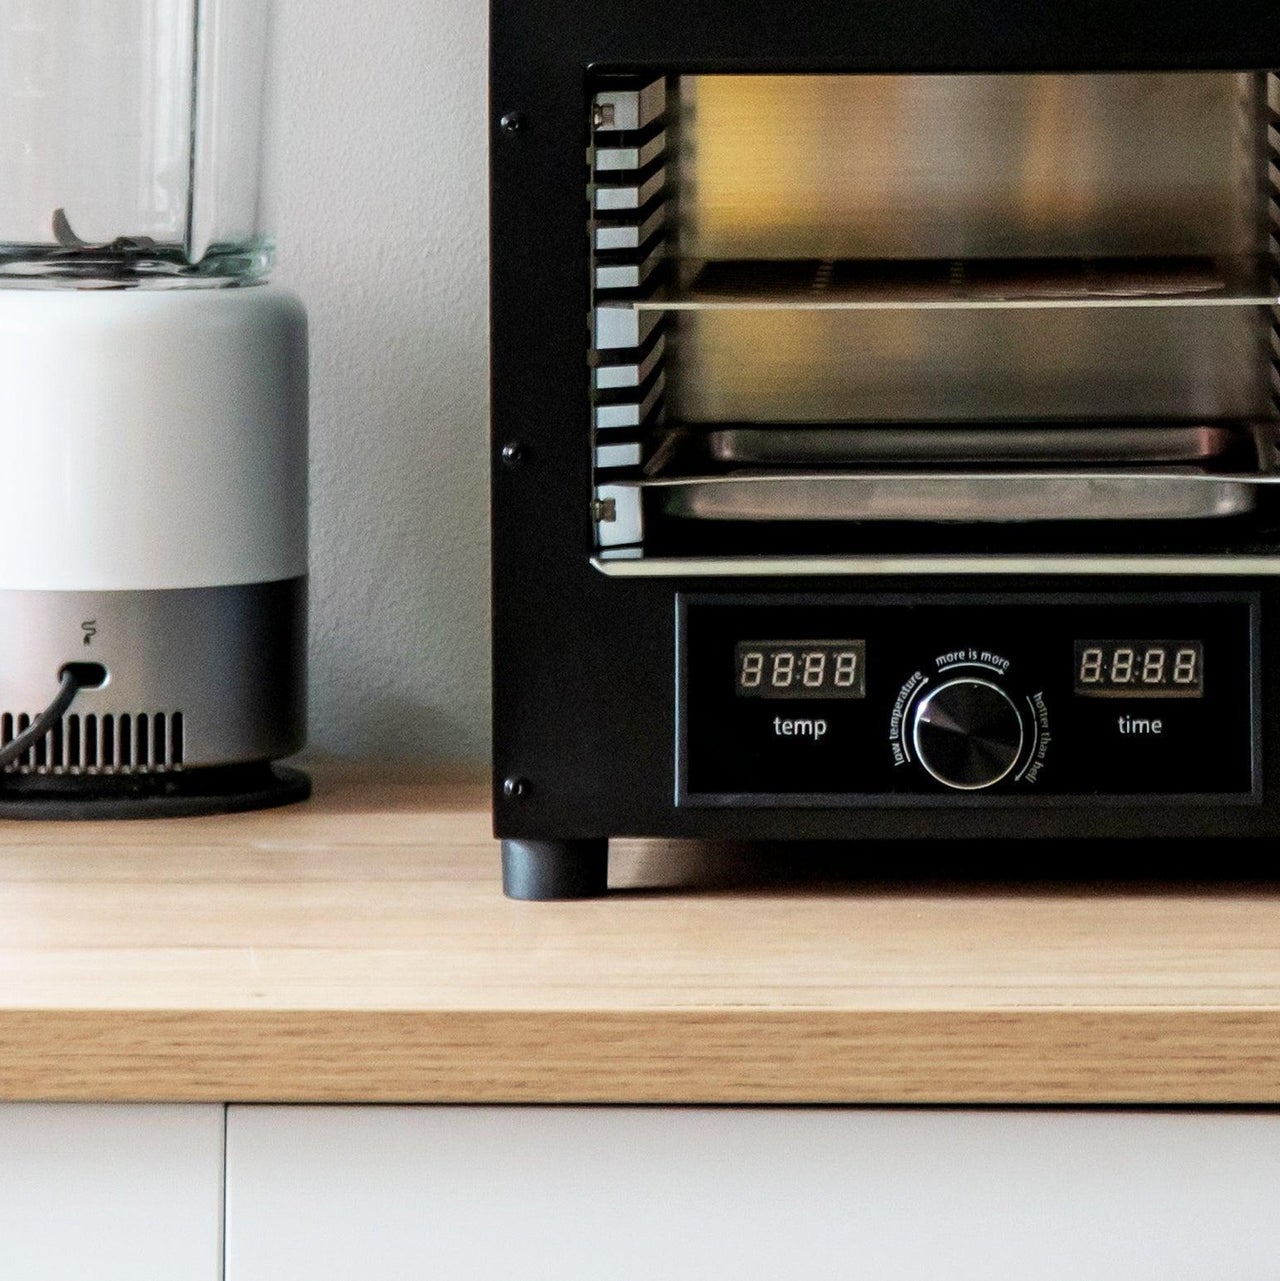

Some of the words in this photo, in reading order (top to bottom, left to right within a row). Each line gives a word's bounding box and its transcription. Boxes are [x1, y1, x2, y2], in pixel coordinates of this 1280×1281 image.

[935, 649, 965, 666] more
[968, 648, 978, 660] is
[980, 651, 1010, 669] more
[889, 671, 922, 739] temperature
[1032, 691, 1049, 728] hotter
[773, 716, 827, 740] temp
[1118, 715, 1162, 733] time
[892, 743, 905, 766] low
[1038, 731, 1052, 759] than
[1024, 761, 1045, 783] hell
